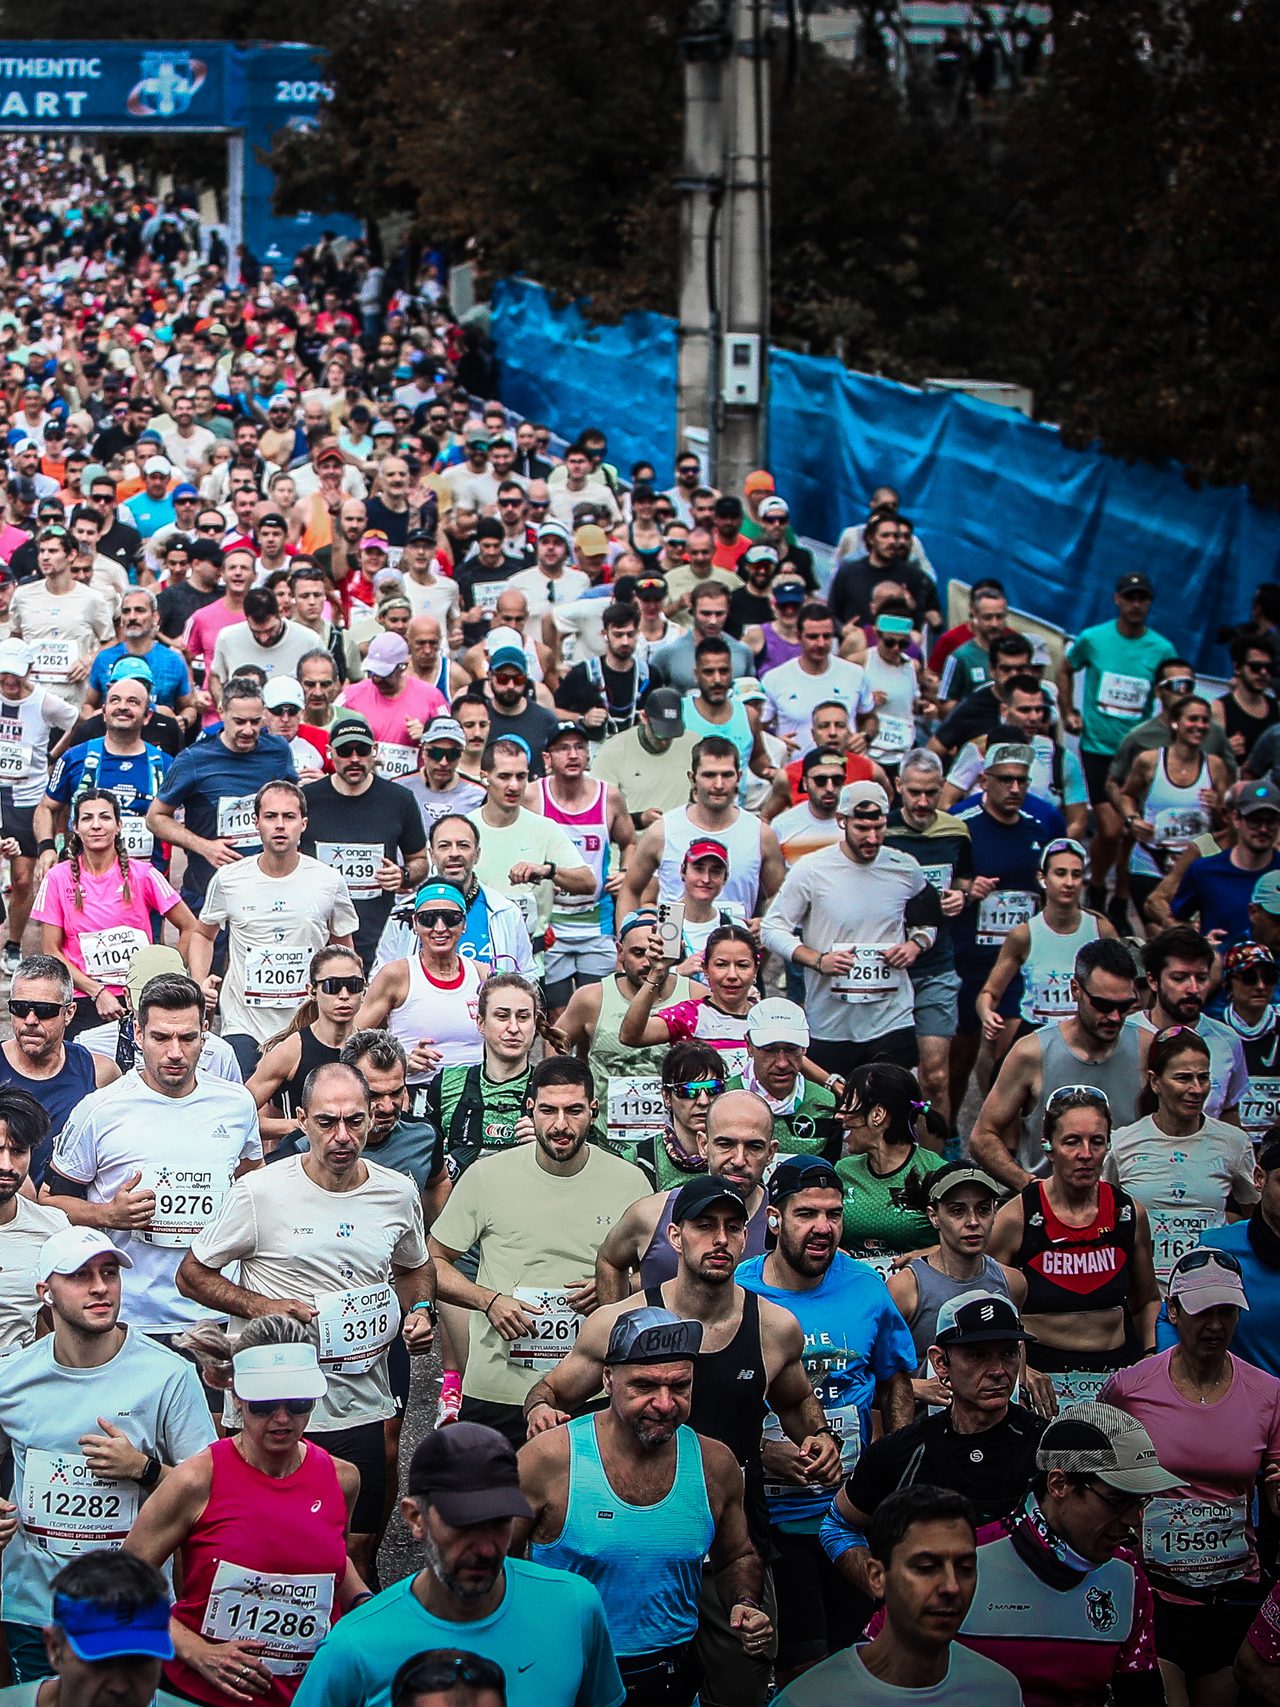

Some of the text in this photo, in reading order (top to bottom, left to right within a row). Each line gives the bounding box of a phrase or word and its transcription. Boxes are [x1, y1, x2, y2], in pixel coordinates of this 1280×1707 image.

[37, 655, 68, 666] 12621
[255, 970, 306, 985] 12067
[620, 1100, 665, 1116] 1192
[160, 1195, 214, 1216] 9276
[1043, 1246, 1118, 1276] GERMANY
[343, 1313, 389, 1343] 3318
[646, 1326, 685, 1350] Buff
[40, 1490, 121, 1518] 12282
[1159, 1530, 1234, 1555] 15597
[227, 1603, 316, 1639] 11286
